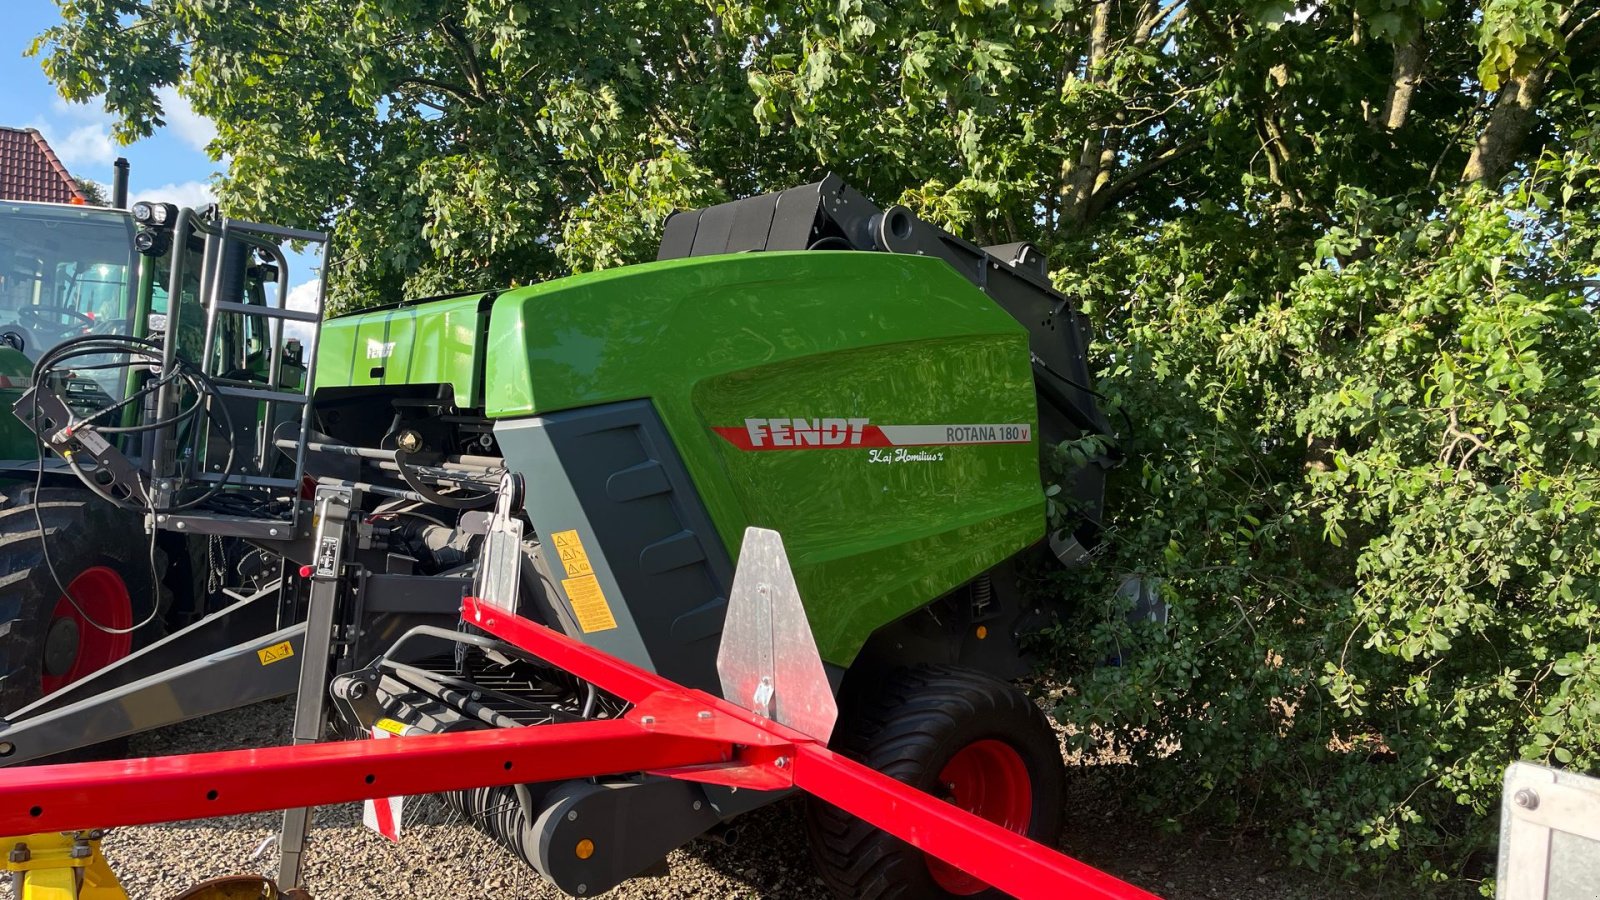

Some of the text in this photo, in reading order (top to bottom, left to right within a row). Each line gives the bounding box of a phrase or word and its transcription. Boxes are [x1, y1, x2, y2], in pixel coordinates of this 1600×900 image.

[744, 418, 870, 446] FENDT
[946, 426, 997, 441] ROTANA
[999, 426, 1019, 440] 180
[868, 449, 892, 464] Kaj
[894, 448, 936, 463] Homilius
